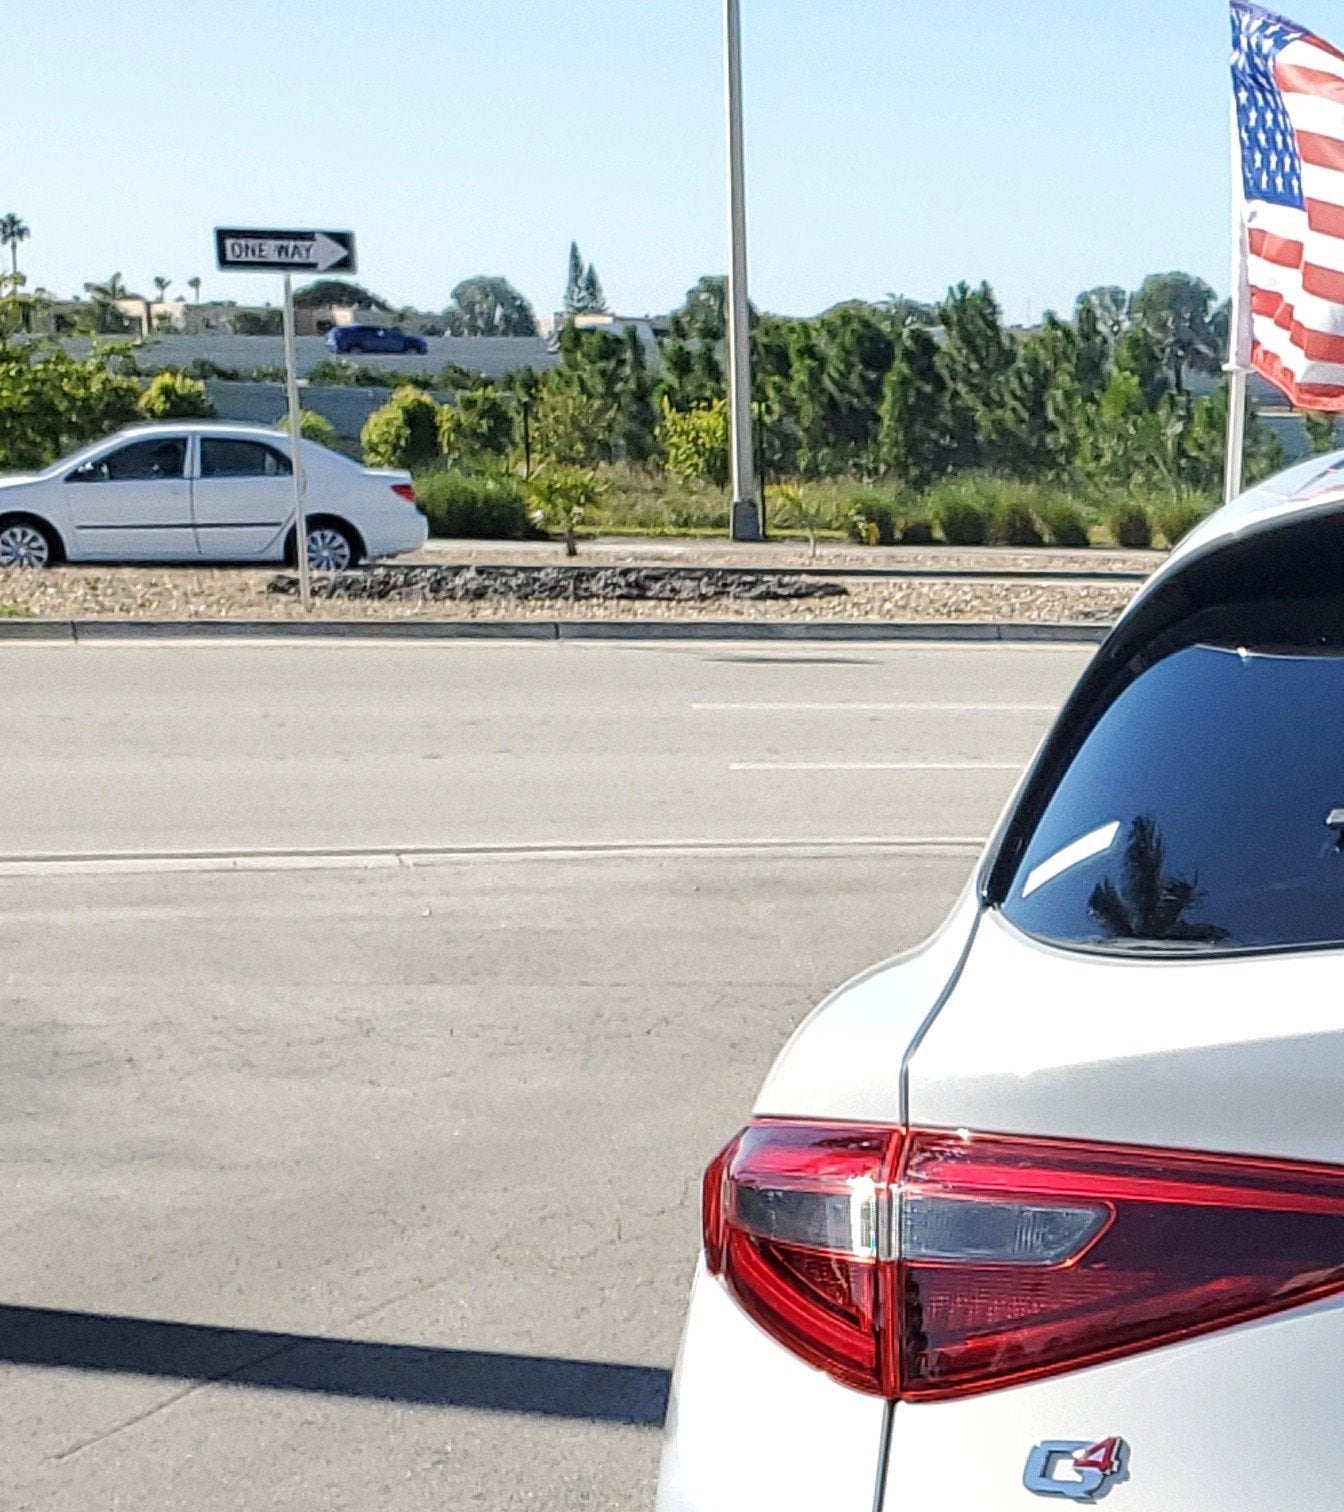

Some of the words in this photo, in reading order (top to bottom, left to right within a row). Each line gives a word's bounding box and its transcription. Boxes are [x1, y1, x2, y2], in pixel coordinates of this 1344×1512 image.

[230, 241, 267, 259] ONE
[275, 241, 315, 260] WAY
[1021, 1436, 1126, 1503] Q4
